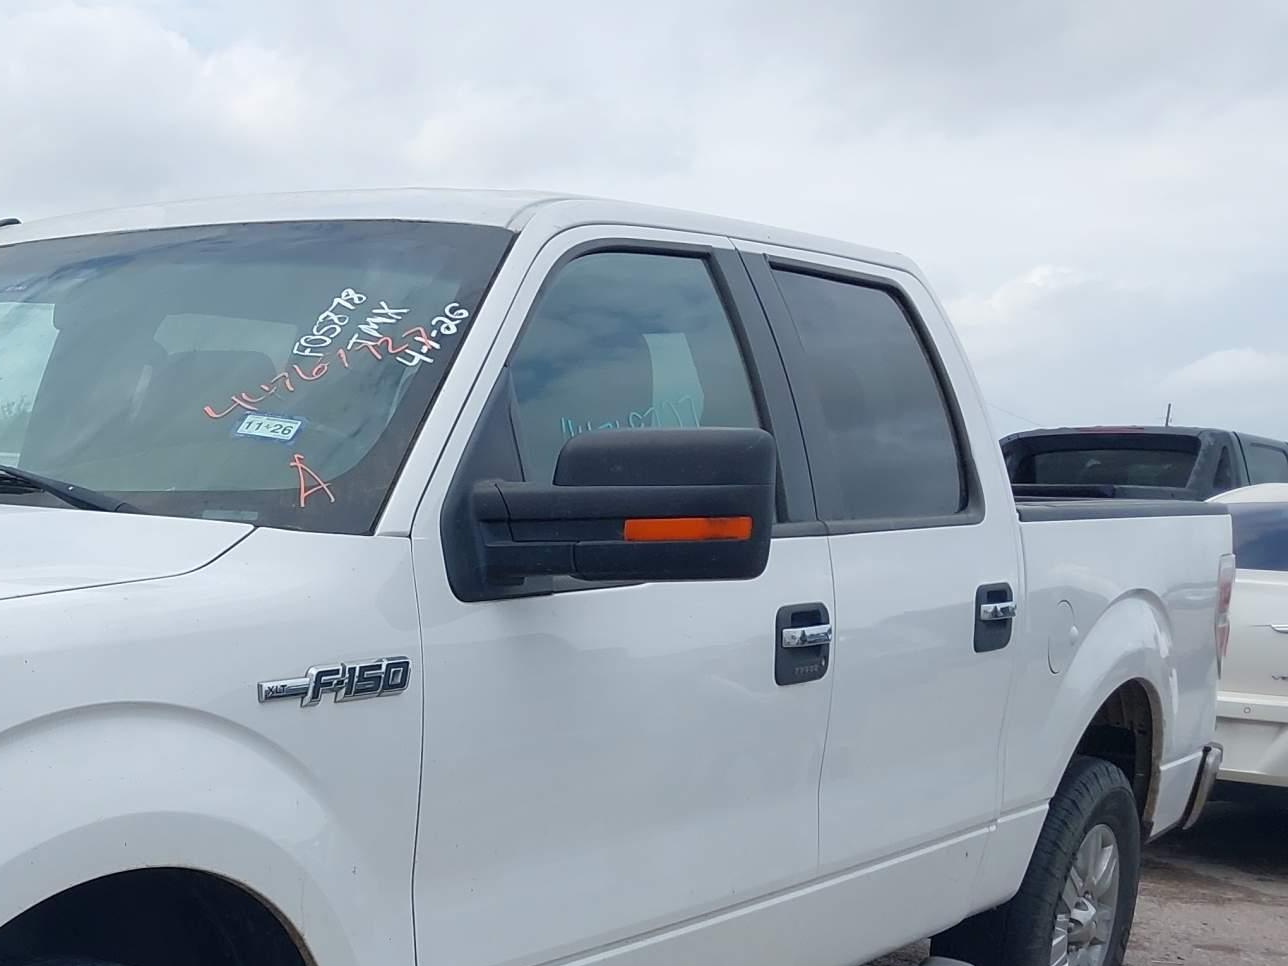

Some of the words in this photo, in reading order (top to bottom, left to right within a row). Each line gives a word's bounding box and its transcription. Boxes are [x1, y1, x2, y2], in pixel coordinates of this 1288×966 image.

[270, 423, 295, 436] 26
[289, 453, 335, 508] A
[309, 657, 411, 703] F-150
